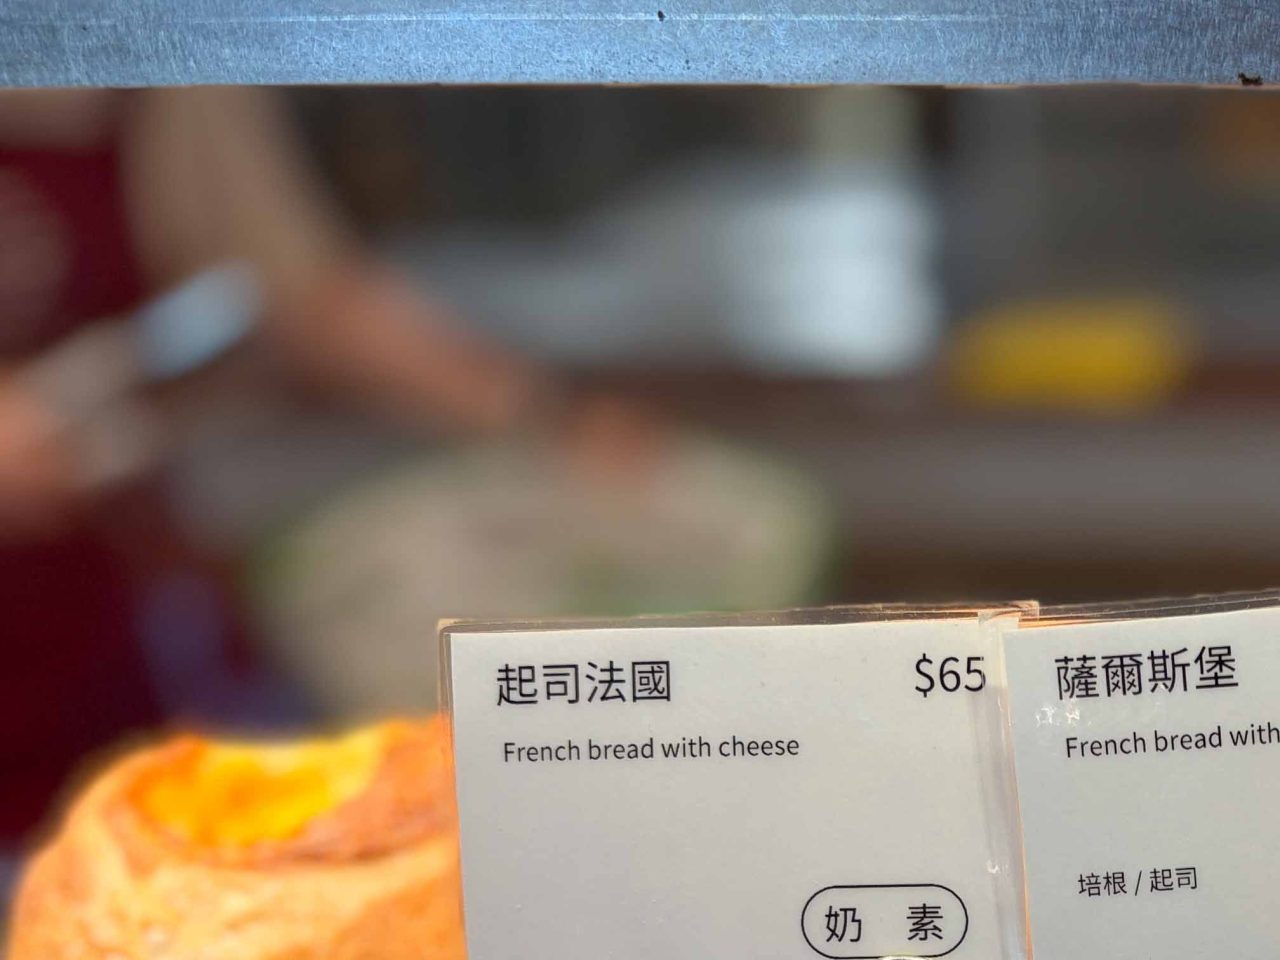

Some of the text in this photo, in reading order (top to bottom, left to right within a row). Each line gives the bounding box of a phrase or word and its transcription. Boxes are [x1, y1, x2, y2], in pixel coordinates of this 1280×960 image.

[496, 660, 671, 707] 起司法國
[914, 652, 986, 698] $65
[1054, 645, 1239, 701] 薩爾斯堡
[503, 735, 800, 763] French bread with cheese
[1065, 731, 1147, 759] French
[1154, 725, 1223, 753] bread
[1229, 721, 1280, 747] with
